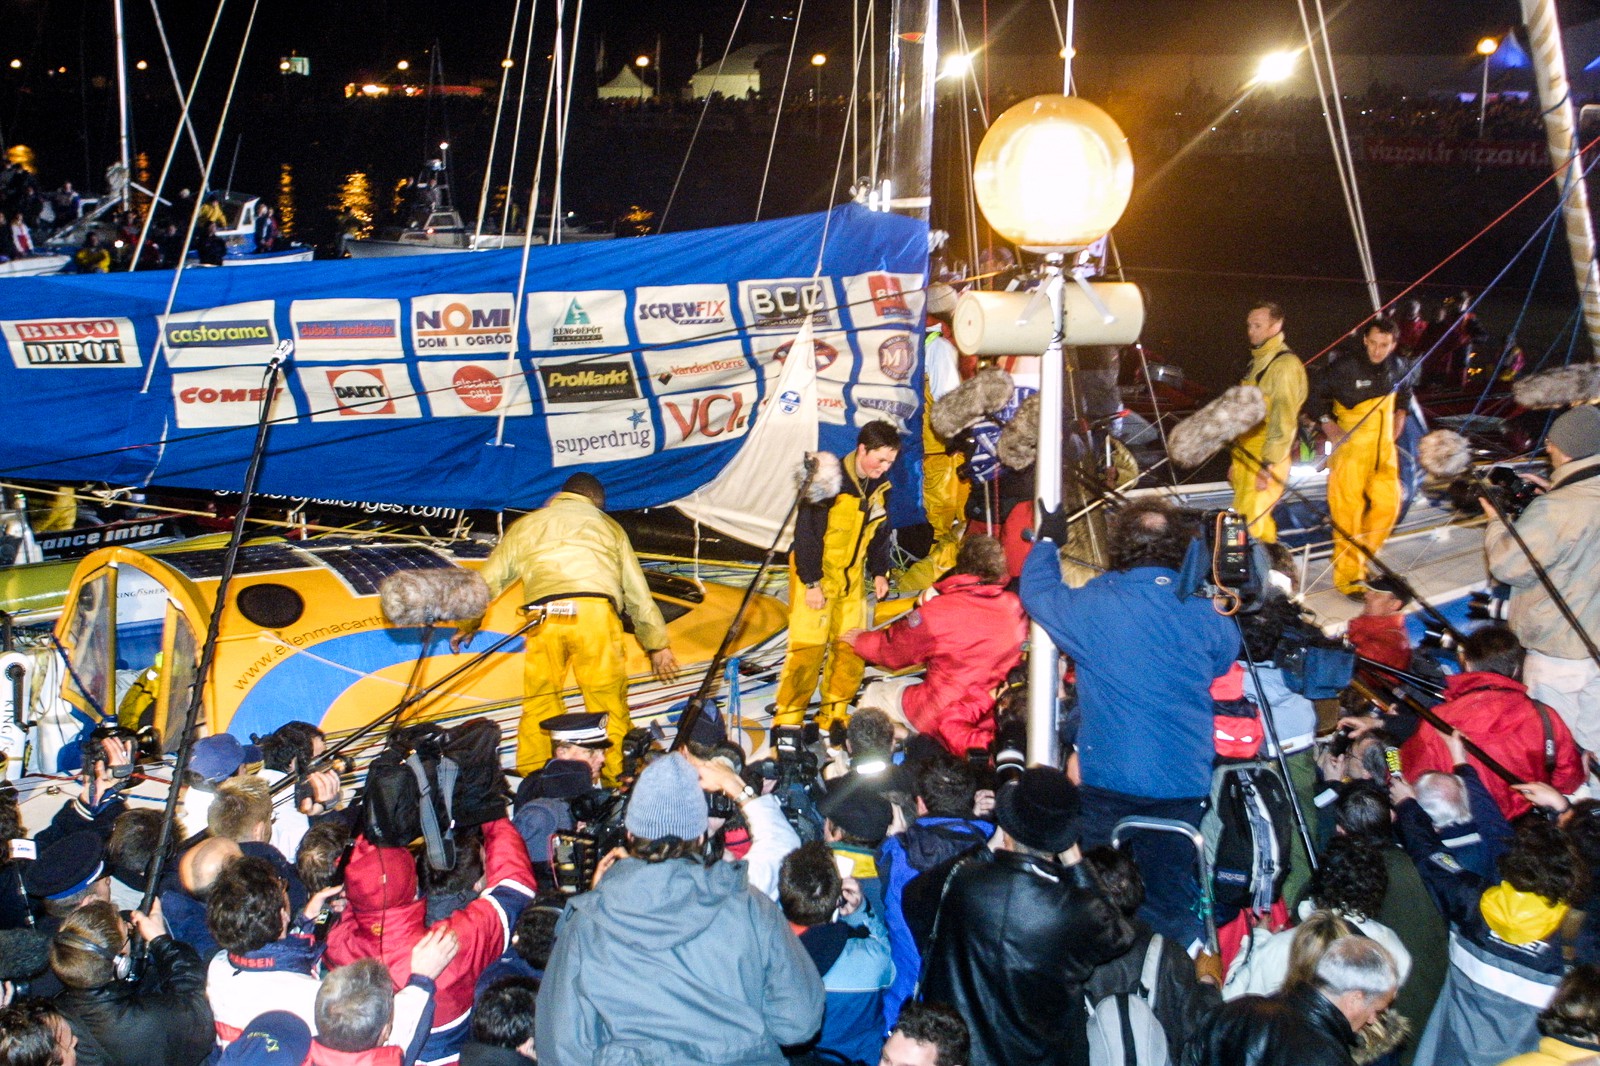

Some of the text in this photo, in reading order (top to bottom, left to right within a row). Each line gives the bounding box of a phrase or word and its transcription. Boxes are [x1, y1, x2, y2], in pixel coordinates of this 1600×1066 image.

[751, 284, 825, 313] BCC
[416, 302, 511, 332] NOMI
[639, 300, 726, 324] SCREWFIX
[19, 322, 115, 339] BRICO
[169, 325, 268, 343] castorama
[418, 332, 512, 348] DOM I OGRÓD
[549, 369, 629, 388] ProMarkt
[180, 387, 284, 403] COMET
[334, 385, 384, 398] DARTY
[555, 429, 651, 456] superdrug
[104, 523, 164, 542] inter
